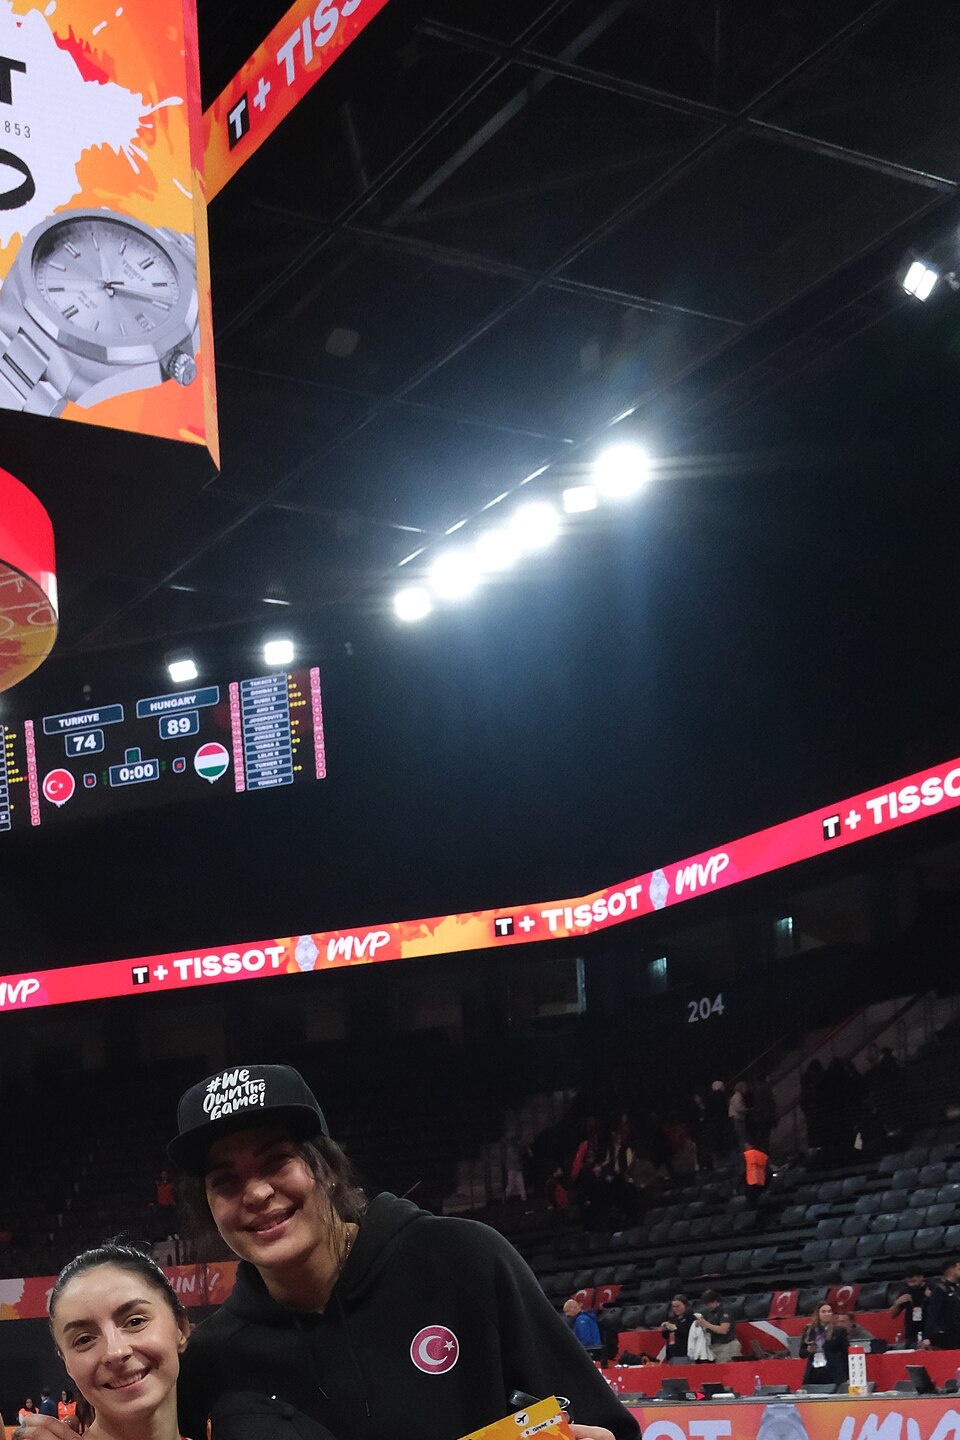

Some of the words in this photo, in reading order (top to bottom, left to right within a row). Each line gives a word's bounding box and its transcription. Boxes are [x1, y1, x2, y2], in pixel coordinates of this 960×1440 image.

[150, 695, 197, 711] HUNGARY
[58, 712, 100, 728] TURKIYE
[167, 717, 191, 735] 89
[73, 734, 97, 752] 74
[119, 764, 154, 781] 0:00
[541, 885, 641, 932] TISSOT
[675, 852, 730, 895] MVP
[173, 946, 285, 980] TISSOT
[326, 931, 391, 962] MVP
[687, 993, 725, 1023] 204
[206, 1068, 250, 1093] #We
[210, 1091, 266, 1121] Game!
